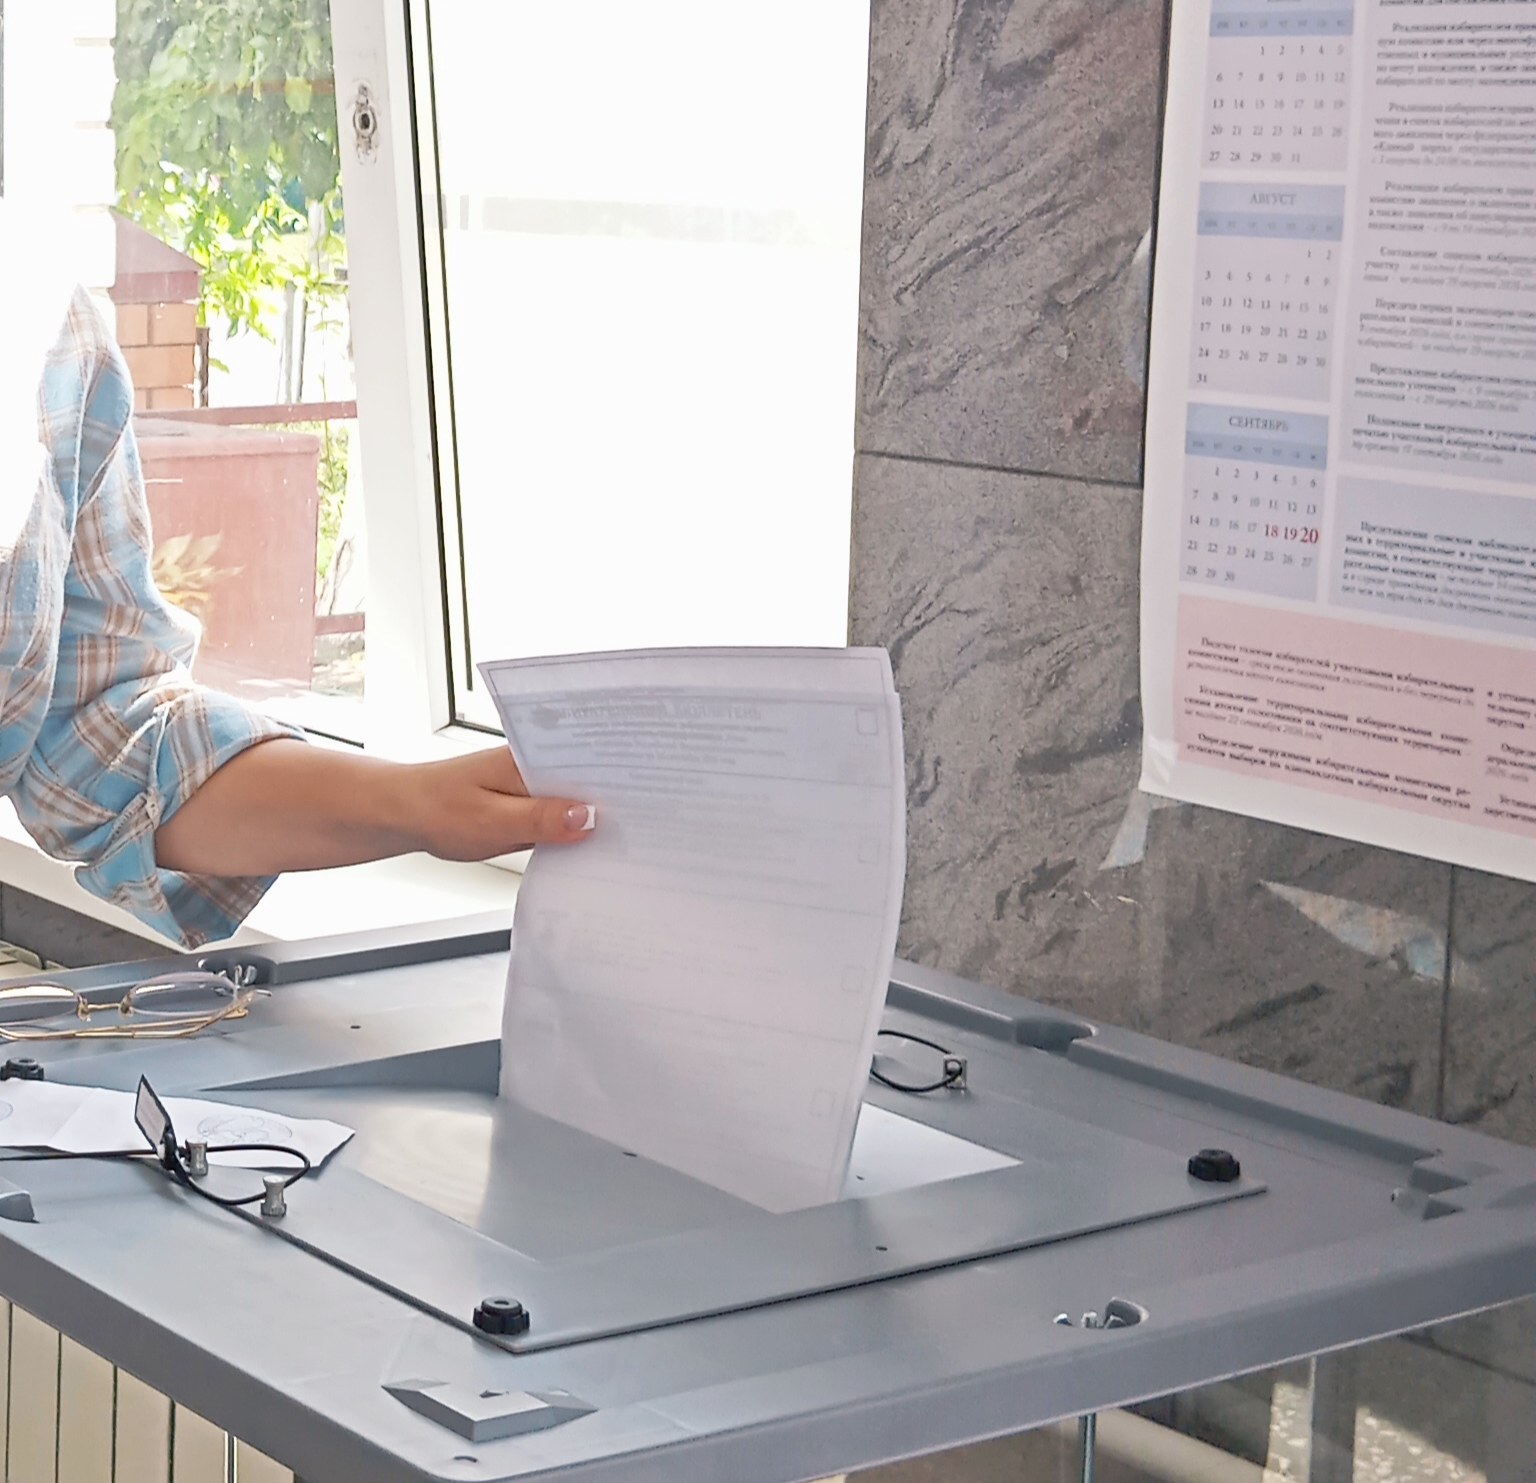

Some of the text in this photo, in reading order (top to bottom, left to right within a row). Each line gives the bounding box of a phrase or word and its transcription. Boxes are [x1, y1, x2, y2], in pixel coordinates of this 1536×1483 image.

[1228, 415, 1290, 433] СЕНТЯБРЬ
[1264, 523, 1279, 538] 18
[1283, 526, 1298, 541] 19
[1299, 526, 1319, 545] 20
